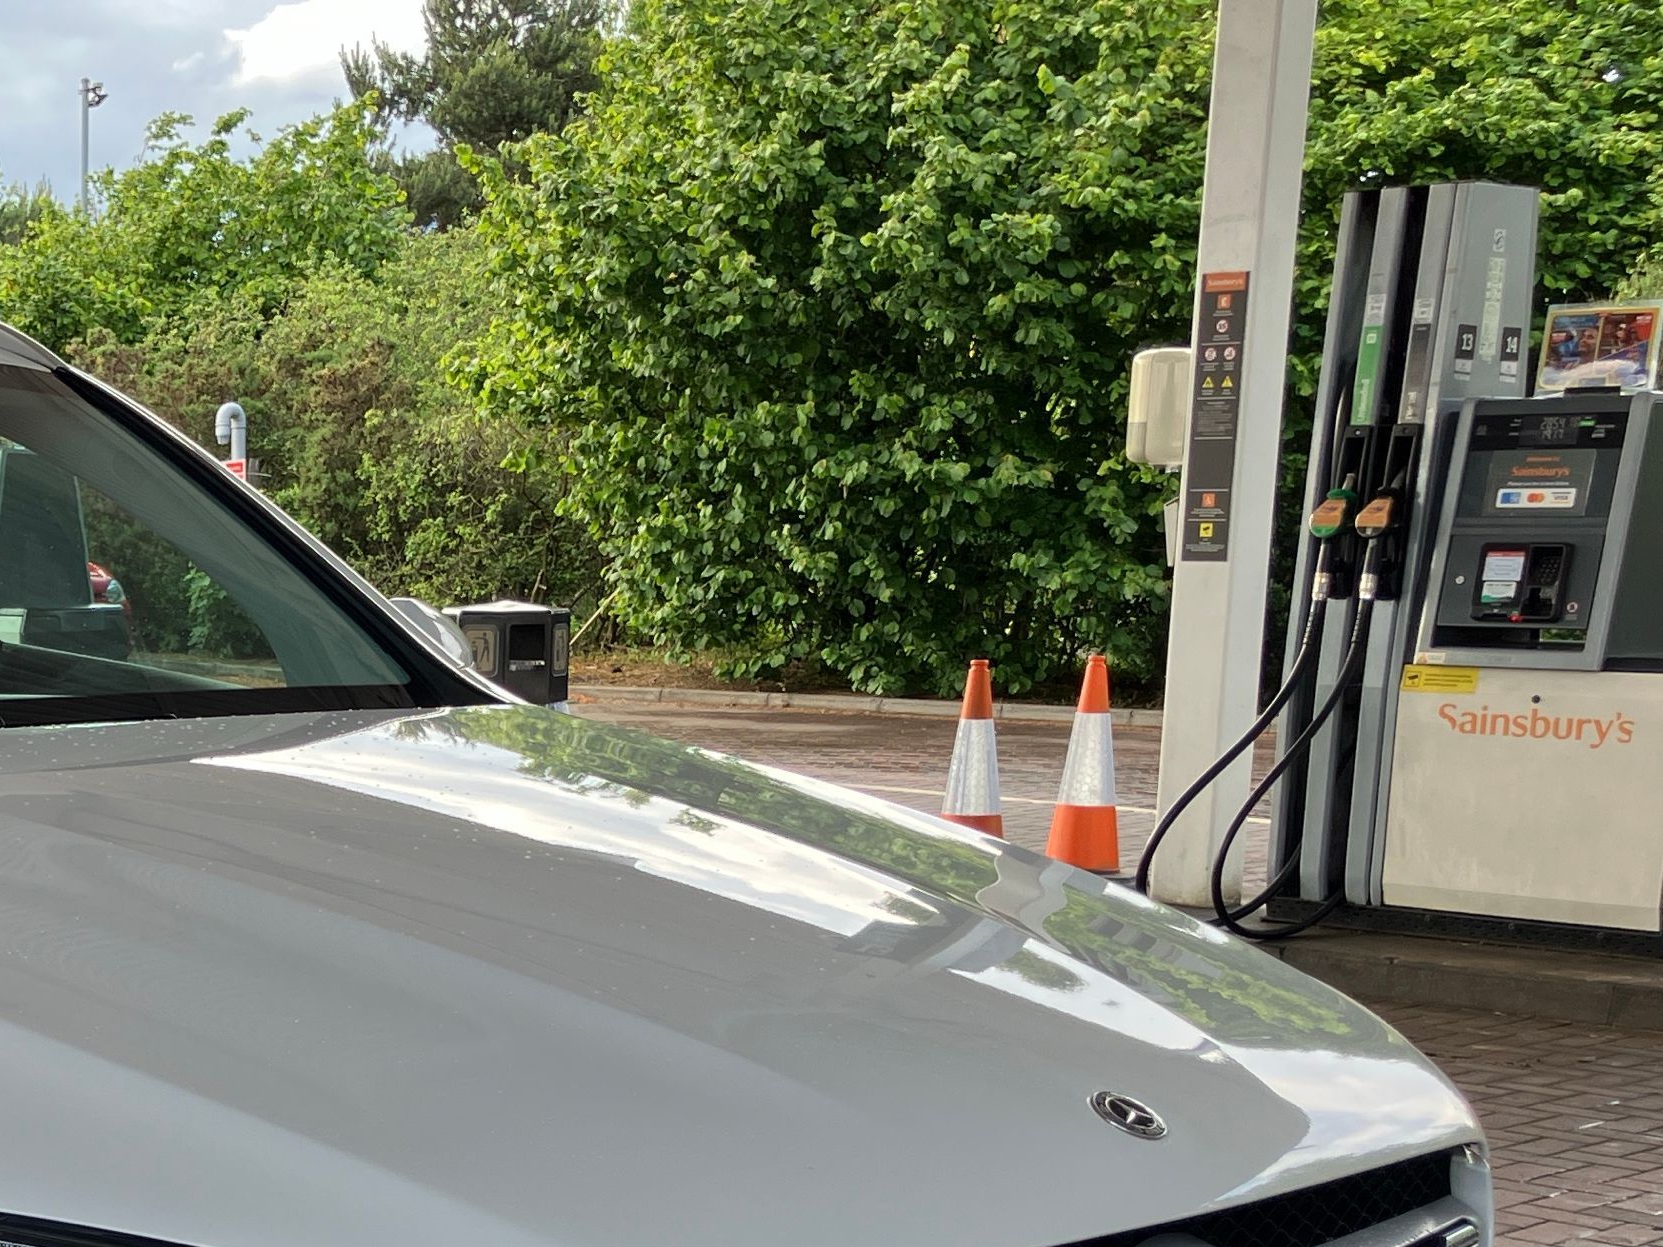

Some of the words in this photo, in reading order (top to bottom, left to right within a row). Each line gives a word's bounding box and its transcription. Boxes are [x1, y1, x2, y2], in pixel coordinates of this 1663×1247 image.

[1461, 333, 1473, 351] 13
[1505, 336, 1518, 353] 14
[1438, 703, 1635, 749] Sainsbury's
